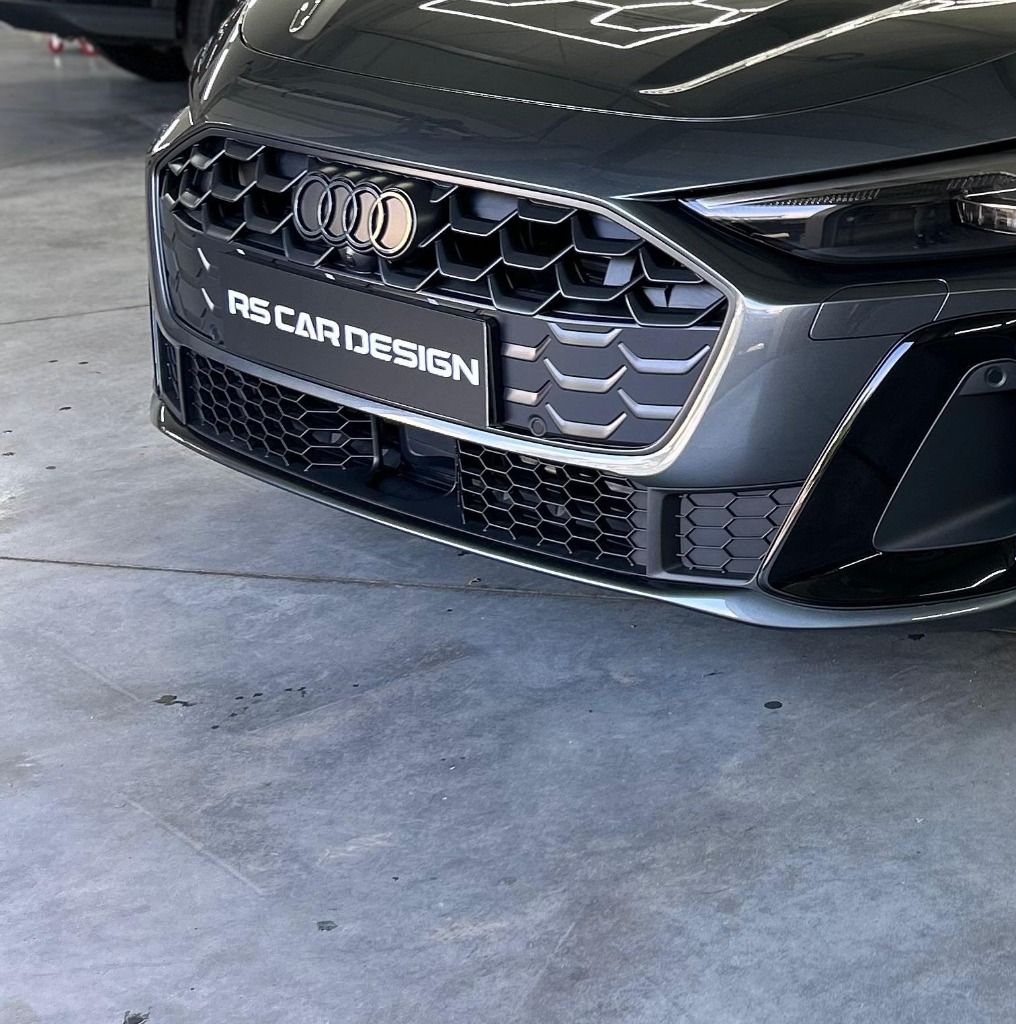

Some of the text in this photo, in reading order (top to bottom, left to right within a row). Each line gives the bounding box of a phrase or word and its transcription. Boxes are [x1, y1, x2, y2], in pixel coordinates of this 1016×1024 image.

[228, 289, 481, 386] RS CAR DESIGN
